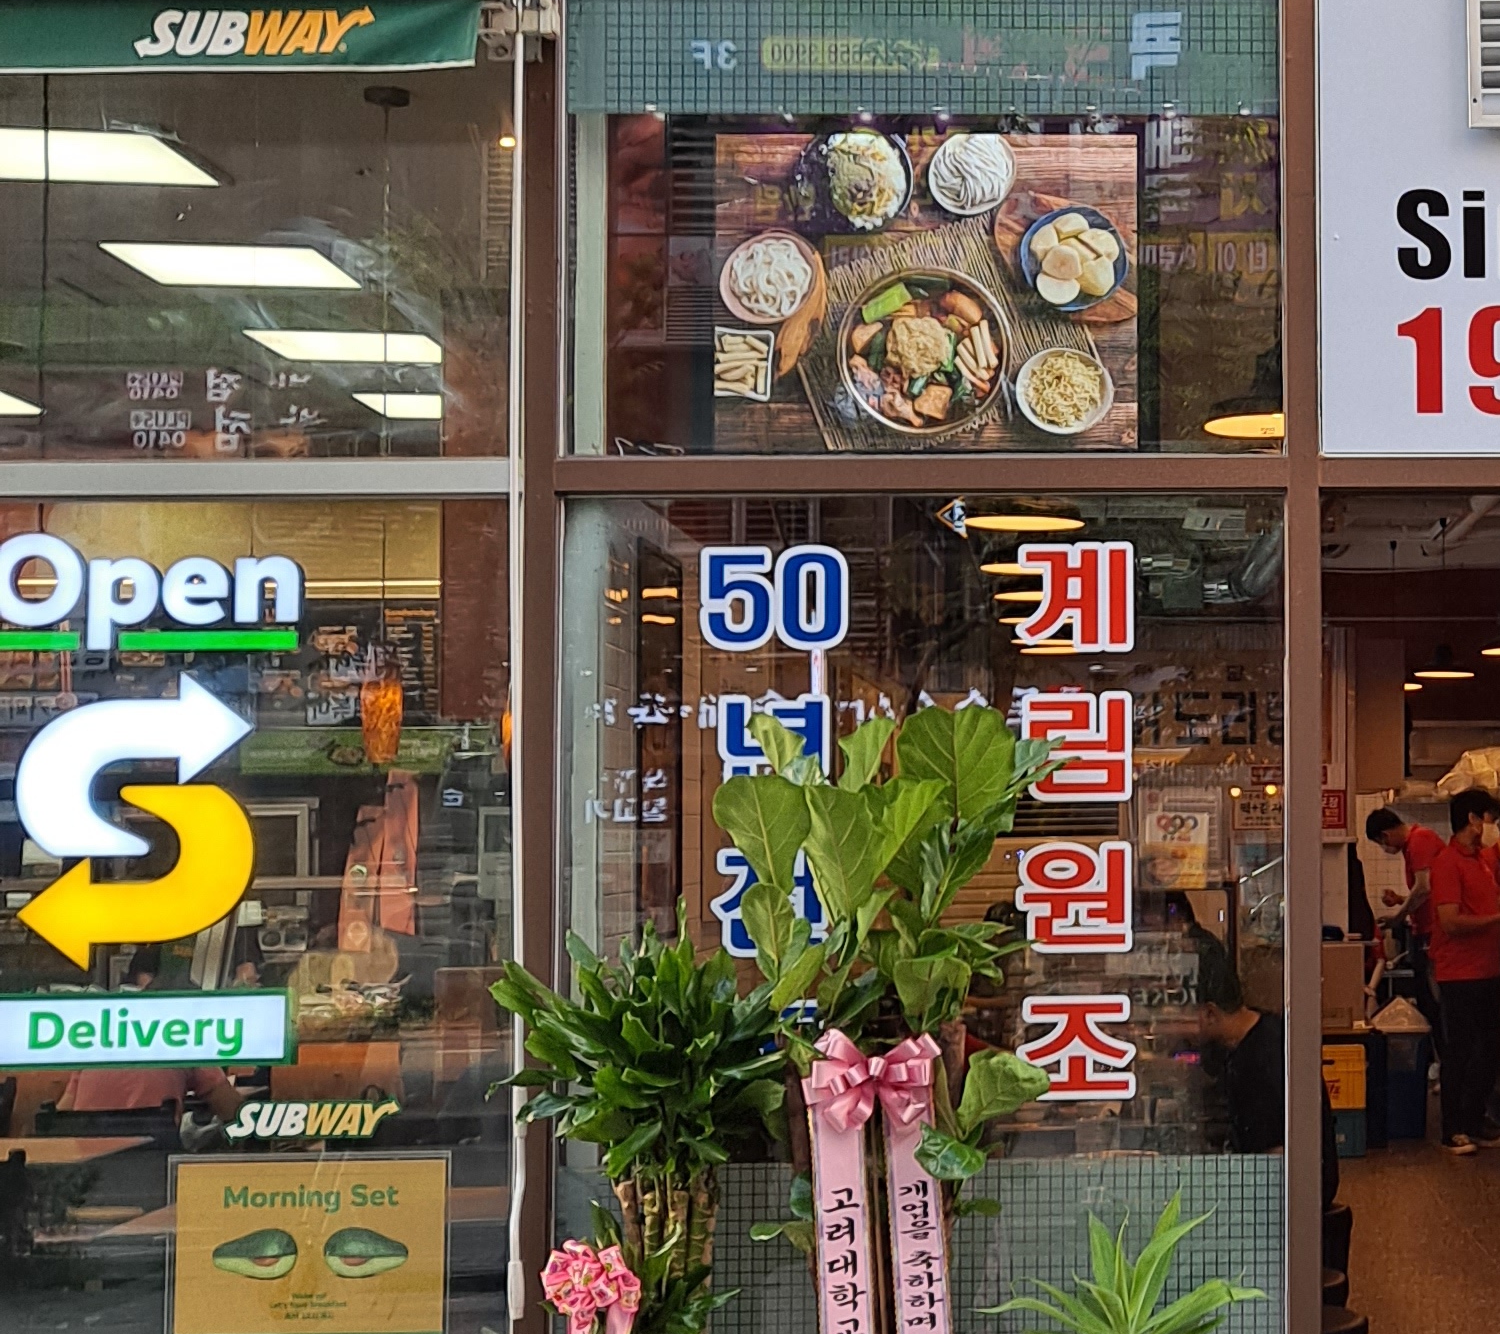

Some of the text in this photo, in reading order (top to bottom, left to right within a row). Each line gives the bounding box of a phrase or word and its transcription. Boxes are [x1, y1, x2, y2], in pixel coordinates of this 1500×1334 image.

[134, 6, 375, 58] SUBWAY
[0, 532, 302, 650] Open
[28, 1009, 244, 1056] Delivery
[225, 1101, 400, 1139] SUBWAY
[223, 1184, 399, 1213] Morning Set
